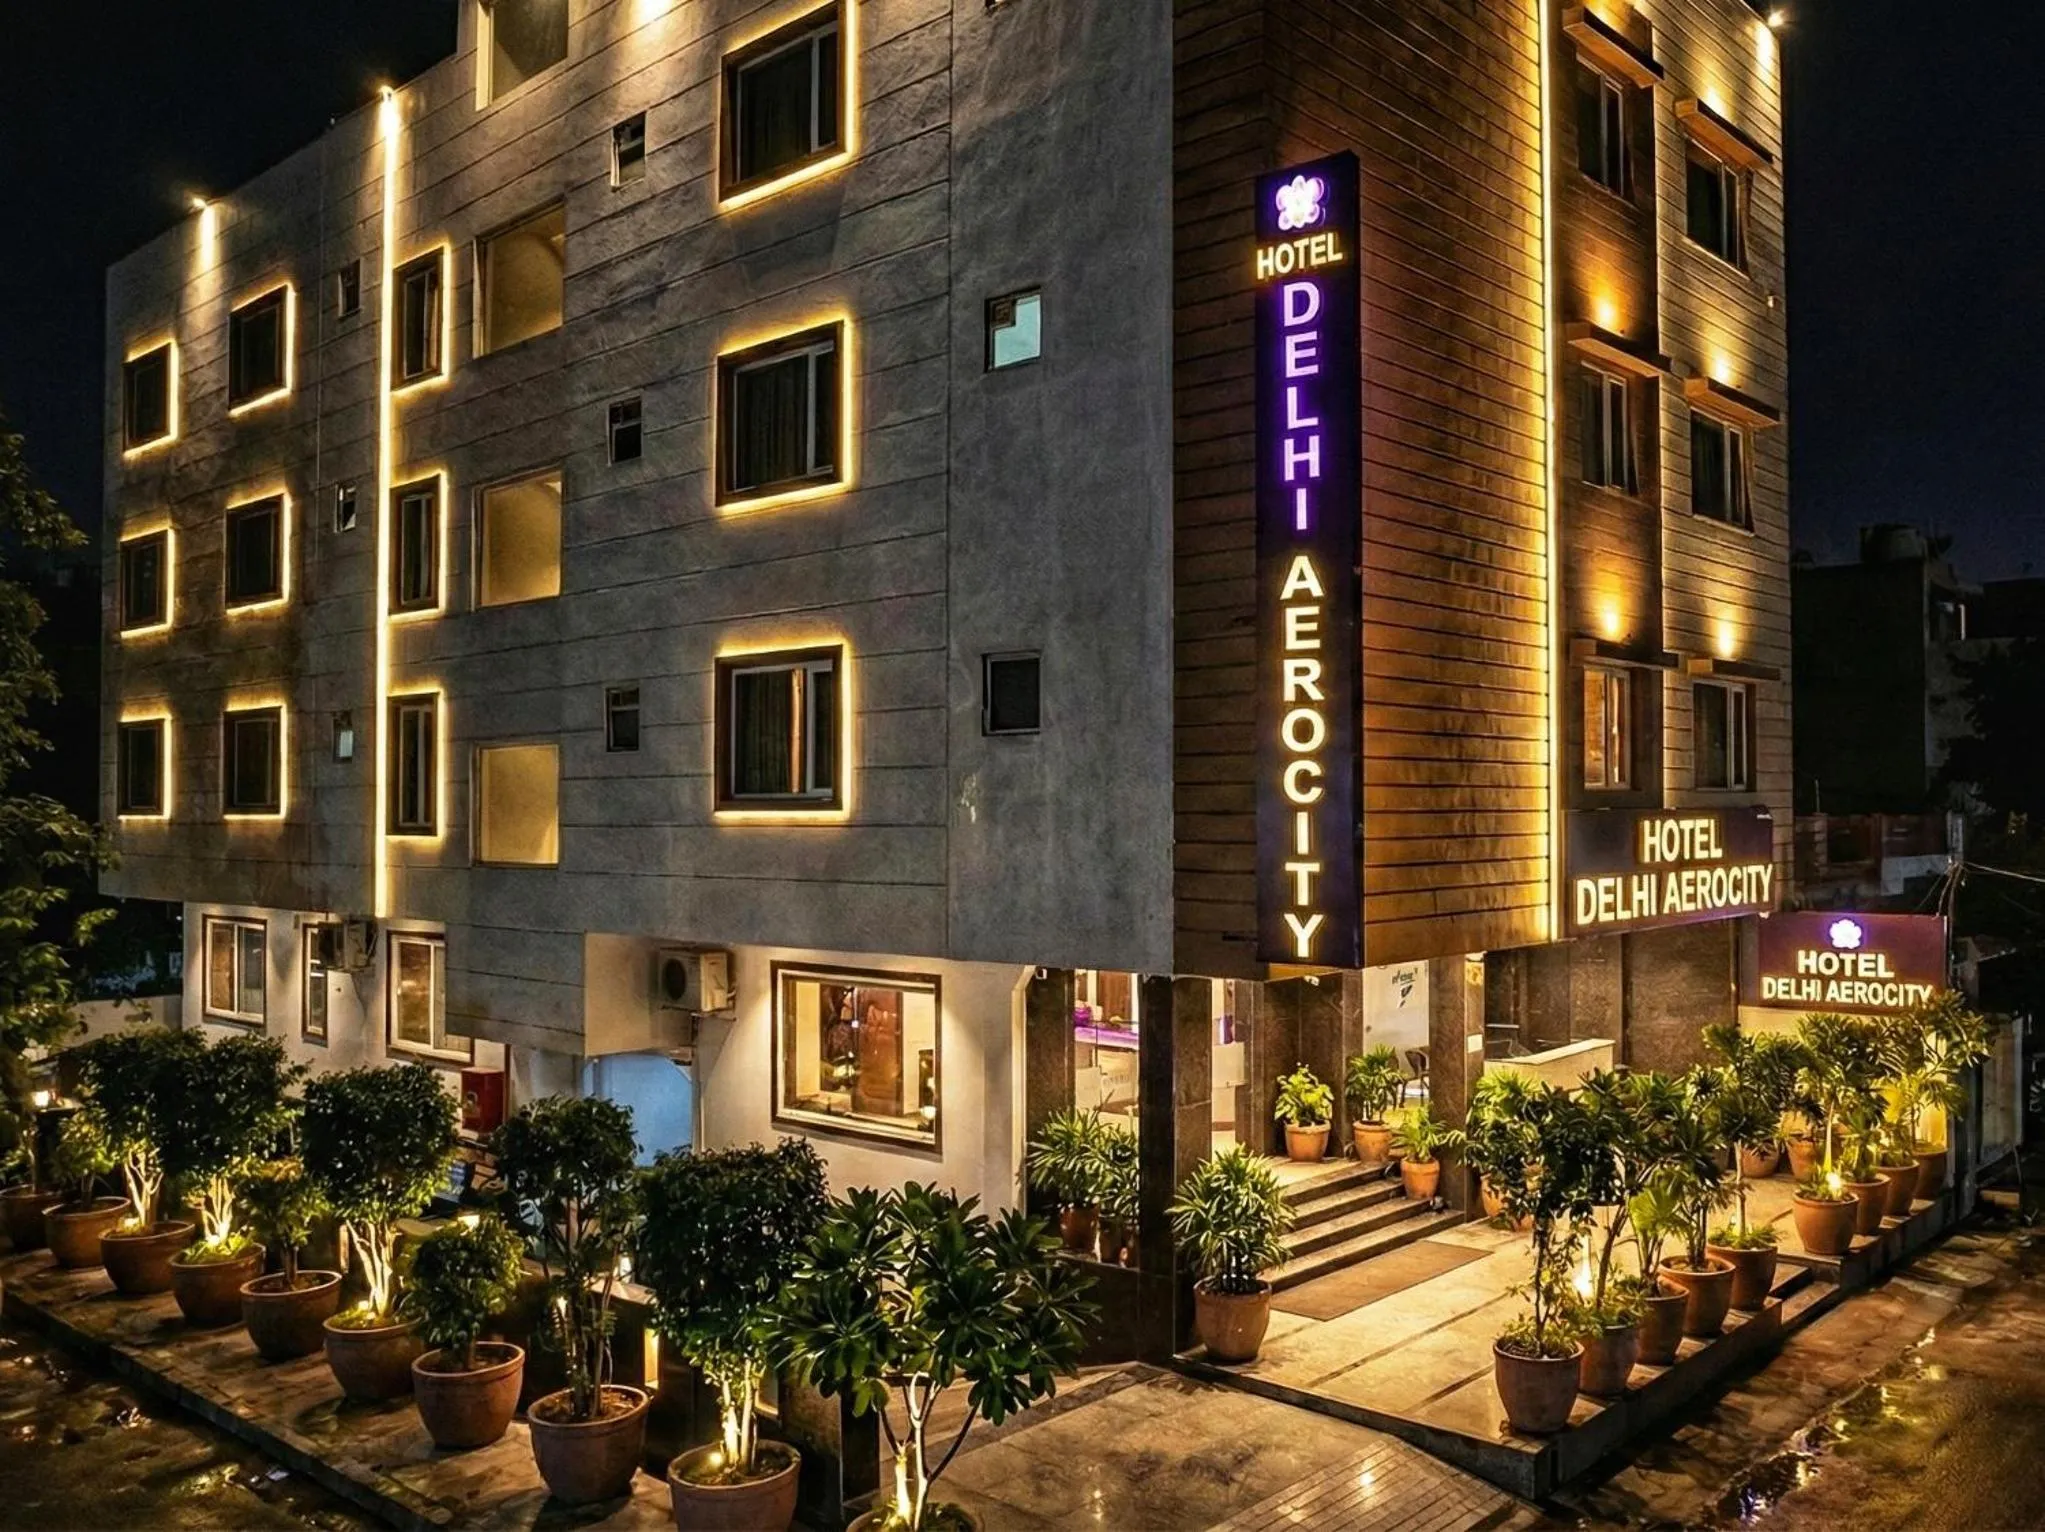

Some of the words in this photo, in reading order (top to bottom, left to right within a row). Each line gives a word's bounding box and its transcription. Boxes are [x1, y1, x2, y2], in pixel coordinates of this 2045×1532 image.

[1256, 232, 1343, 280] HOTEL
[1283, 281, 1321, 530] DELHI
[1280, 555, 1326, 958] AEROCITY
[1642, 818, 1723, 863] HOTEL
[1576, 873, 1657, 925] DELHI
[1663, 863, 1773, 914] AEROCITY
[1797, 950, 1895, 978] HOTEL
[1762, 976, 1821, 1002] DELHI
[1825, 980, 1933, 1008] AEROCITY
